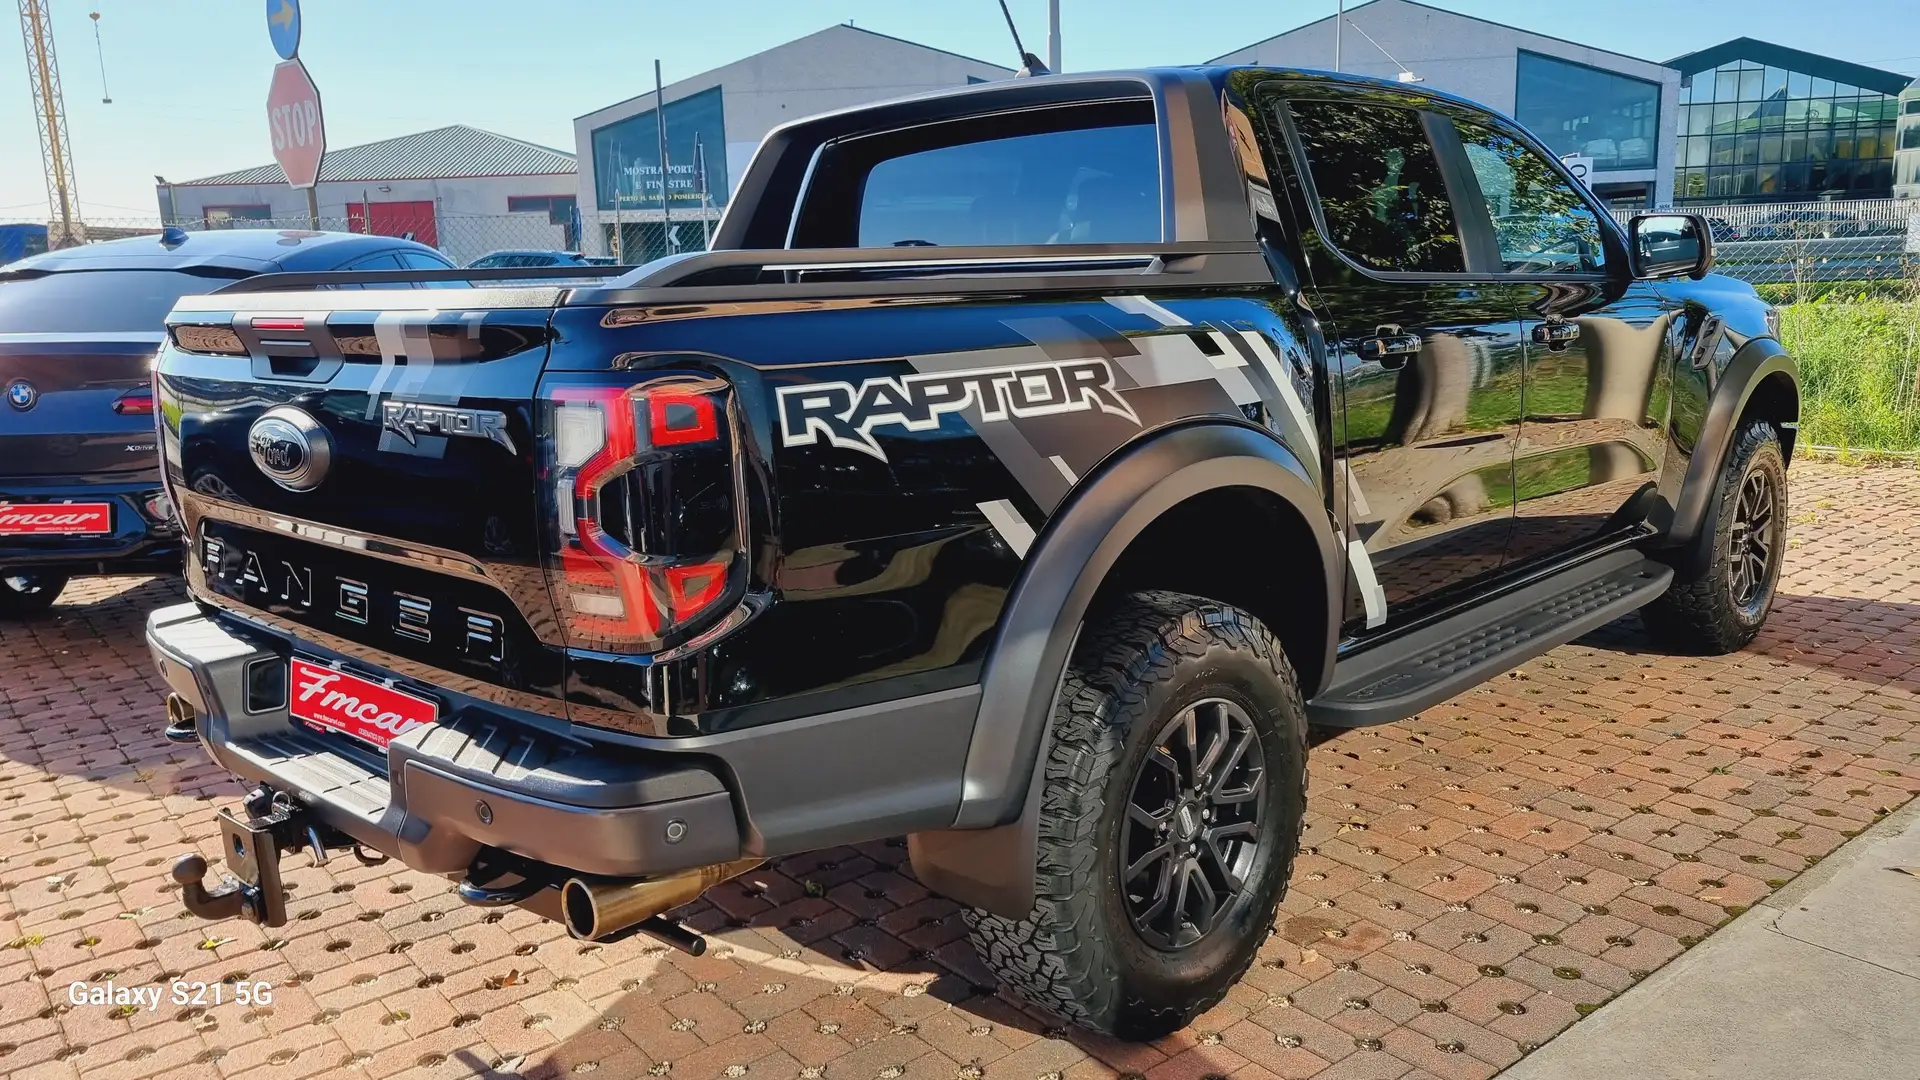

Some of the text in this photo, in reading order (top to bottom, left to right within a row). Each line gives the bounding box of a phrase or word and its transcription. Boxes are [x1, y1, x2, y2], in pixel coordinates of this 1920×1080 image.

[271, 99, 316, 151] STOP
[624, 165, 697, 176] MOSTRA PORT
[635, 180, 693, 190] E FINSTRE
[382, 400, 517, 456] RAPTOR
[775, 357, 1143, 463] RAPTOR
[258, 431, 292, 467] Ford
[0, 506, 100, 525] mcar
[202, 535, 505, 662] RANGER
